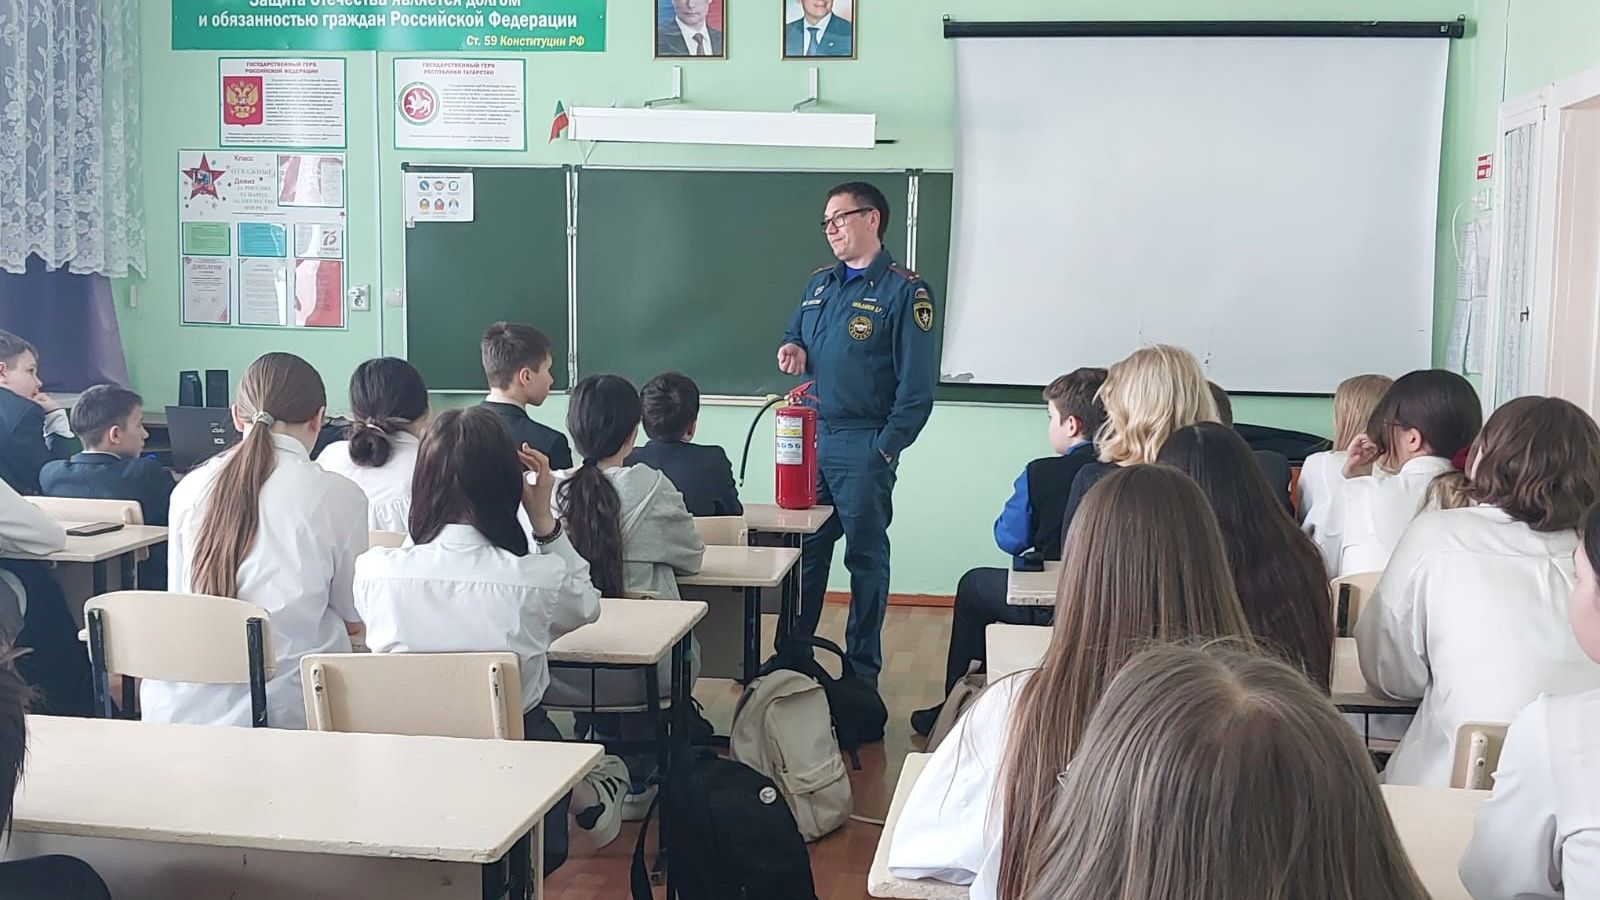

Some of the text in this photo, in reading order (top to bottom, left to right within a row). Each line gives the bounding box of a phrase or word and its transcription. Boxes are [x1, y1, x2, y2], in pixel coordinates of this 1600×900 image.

[198, 10, 578, 31] и обязанностью граждан Российской Федерации
[466, 35, 586, 48] Ст. 59 Конституции РФ
[233, 154, 254, 162] Класс
[233, 177, 255, 185] Девиз
